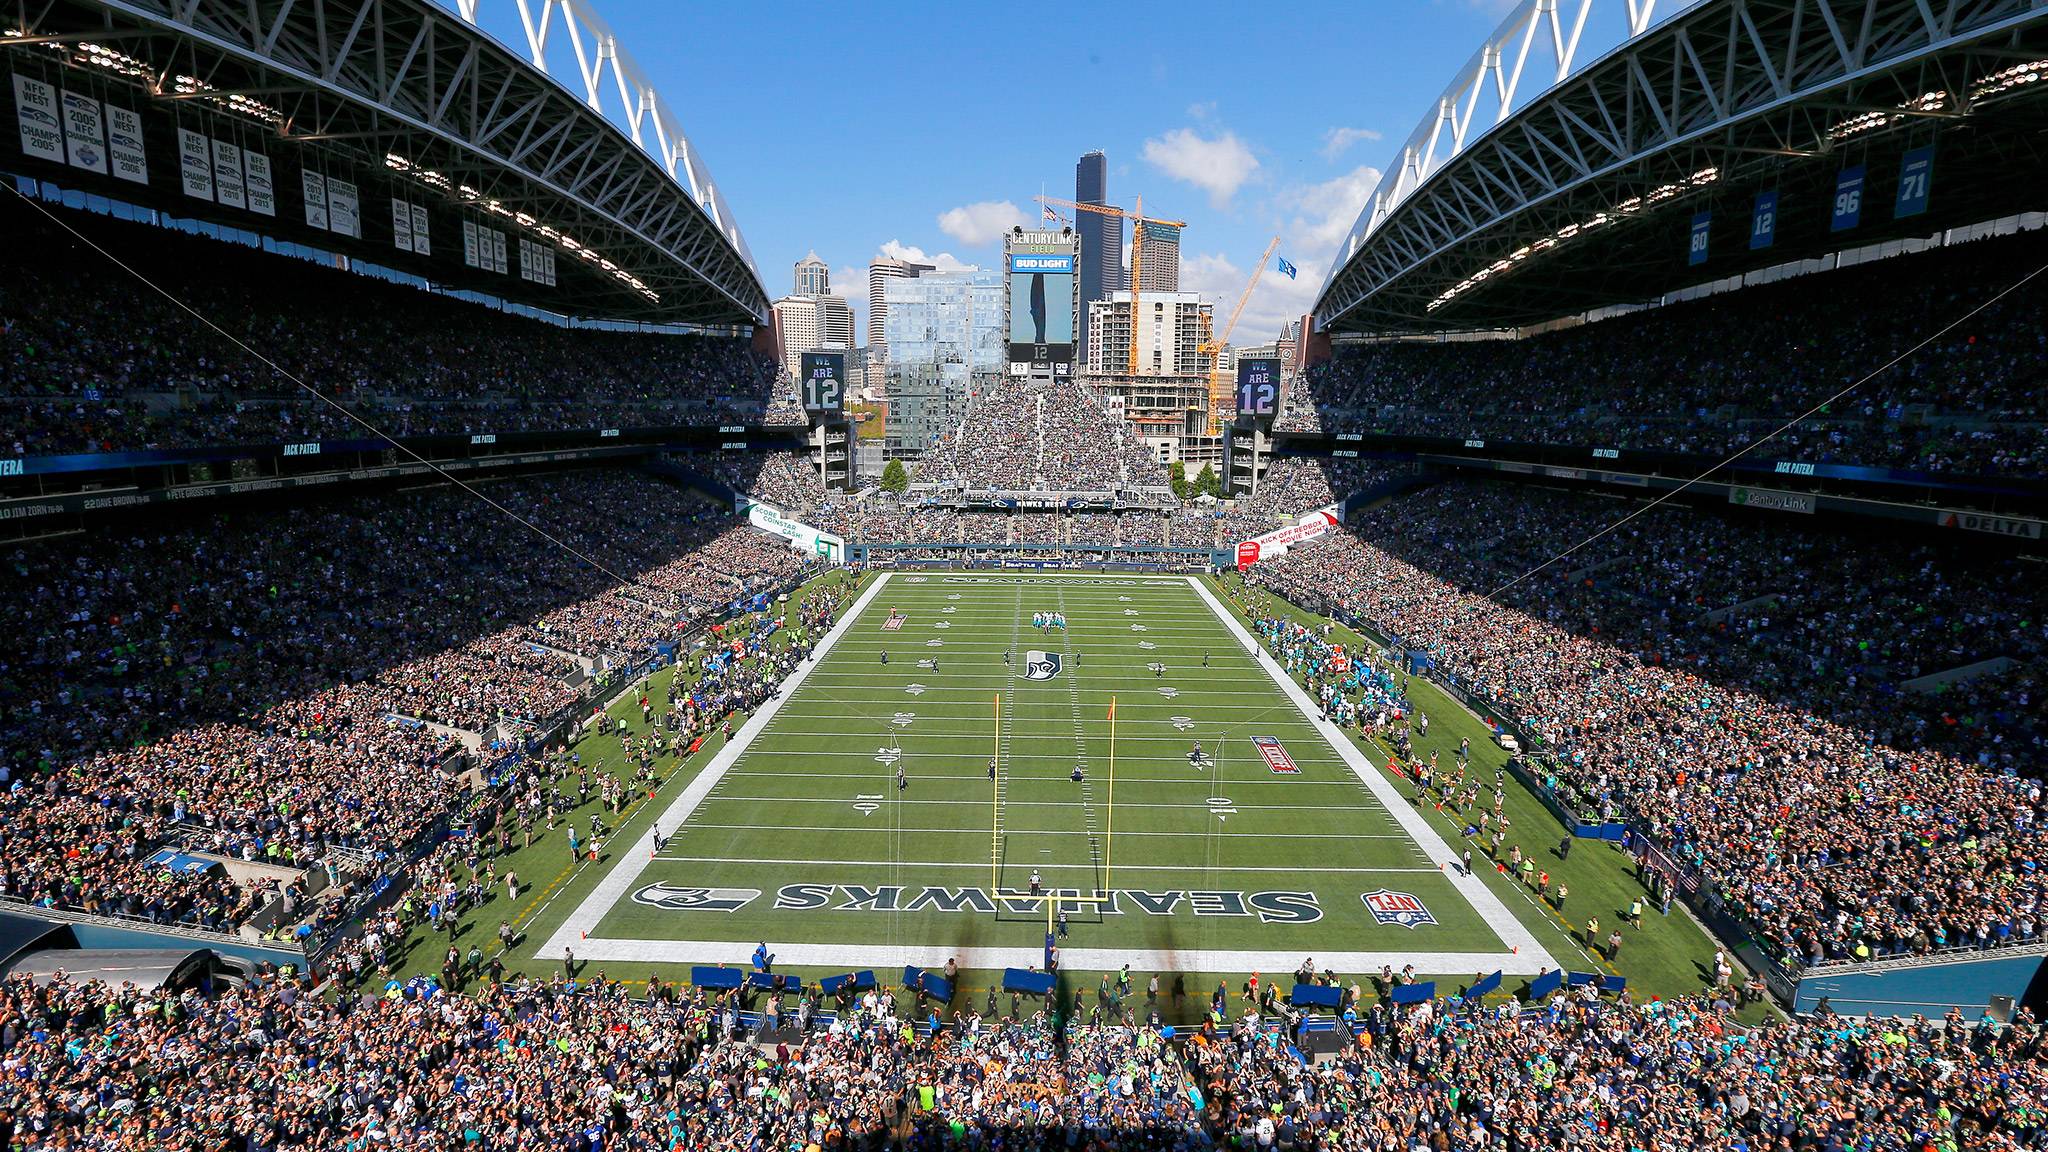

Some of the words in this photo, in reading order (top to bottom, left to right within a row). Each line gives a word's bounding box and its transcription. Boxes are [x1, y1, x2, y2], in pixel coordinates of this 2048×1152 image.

[24, 81, 45, 93] NFC
[22, 90, 49, 107] WEST
[70, 110, 96, 127] 2005
[114, 111, 132, 123] NFC
[75, 123, 94, 136] NFC
[113, 119, 136, 134] WEST
[21, 124, 61, 144] CHAMPS
[66, 130, 104, 147] CHAMPIONS
[186, 134, 201, 144] NFC
[31, 137, 55, 152] 2005
[184, 141, 203, 154] WEST
[219, 144, 233, 155] NFC
[112, 150, 145, 167] CHAMPS
[218, 152, 236, 165] WEST
[250, 155, 264, 166] NFC
[120, 161, 141, 174] 2006
[250, 162, 266, 175] WEST
[183, 169, 211, 185] CHAMPS
[190, 180, 206, 192] 2007
[217, 179, 243, 193] CHAMPS
[1902, 173, 1926, 200] 71
[223, 190, 239, 200] 2010
[248, 188, 272, 202] CHAMPS
[1836, 190, 1860, 216] 96
[1755, 213, 1772, 235] 12
[1012, 232, 1072, 245] CENTURYLINK
[1692, 232, 1707, 252] 80
[1030, 245, 1055, 253] FIELD
[1016, 259, 1037, 268] BUD
[1038, 259, 1068, 268] LIGHT
[1034, 347, 1047, 359] 12
[815, 357, 830, 366] WE
[1252, 362, 1267, 371] WE
[813, 367, 833, 378] ARE
[1249, 373, 1269, 383] ARE
[805, 378, 838, 409] 12
[1240, 384, 1274, 415] 12
[284, 444, 299, 456] JACK
[299, 442, 320, 455] PATERA
[1774, 461, 1790, 473] JACK
[1790, 463, 1815, 476] PATERA
[171, 488, 185, 499] PETE
[185, 487, 204, 497] GROSS
[84, 500, 97, 509] 22
[97, 499, 112, 509] DAVE
[113, 496, 136, 506] BROWN
[1016, 500, 1042, 508] HAWKS
[1045, 500, 1063, 508] NEST
[1748, 492, 1808, 511] CenturyLink
[12, 508, 27, 518] JIM
[28, 505, 47, 516] ZORN
[755, 506, 778, 519] SCORE
[763, 516, 797, 531] COINSTAR
[1964, 514, 2030, 536] DELTA
[782, 528, 803, 539] CASH!
[1260, 534, 1277, 545] KICK
[1279, 529, 1293, 539] OFF
[1294, 520, 1322, 534] REDBOX
[1280, 534, 1302, 545] MOVIE
[1304, 524, 1328, 537] NIGHT!
[942, 577, 1137, 586] SEAHAWKS
[853, 794, 883, 811] 10
[1206, 798, 1238, 814] 10
[773, 884, 1324, 923] SEAHAWKS
[1368, 893, 1421, 911] NFL
[1939, 1065, 1950, 1074] 25
[885, 1097, 894, 1108] 12
[588, 1130, 601, 1142] 96
